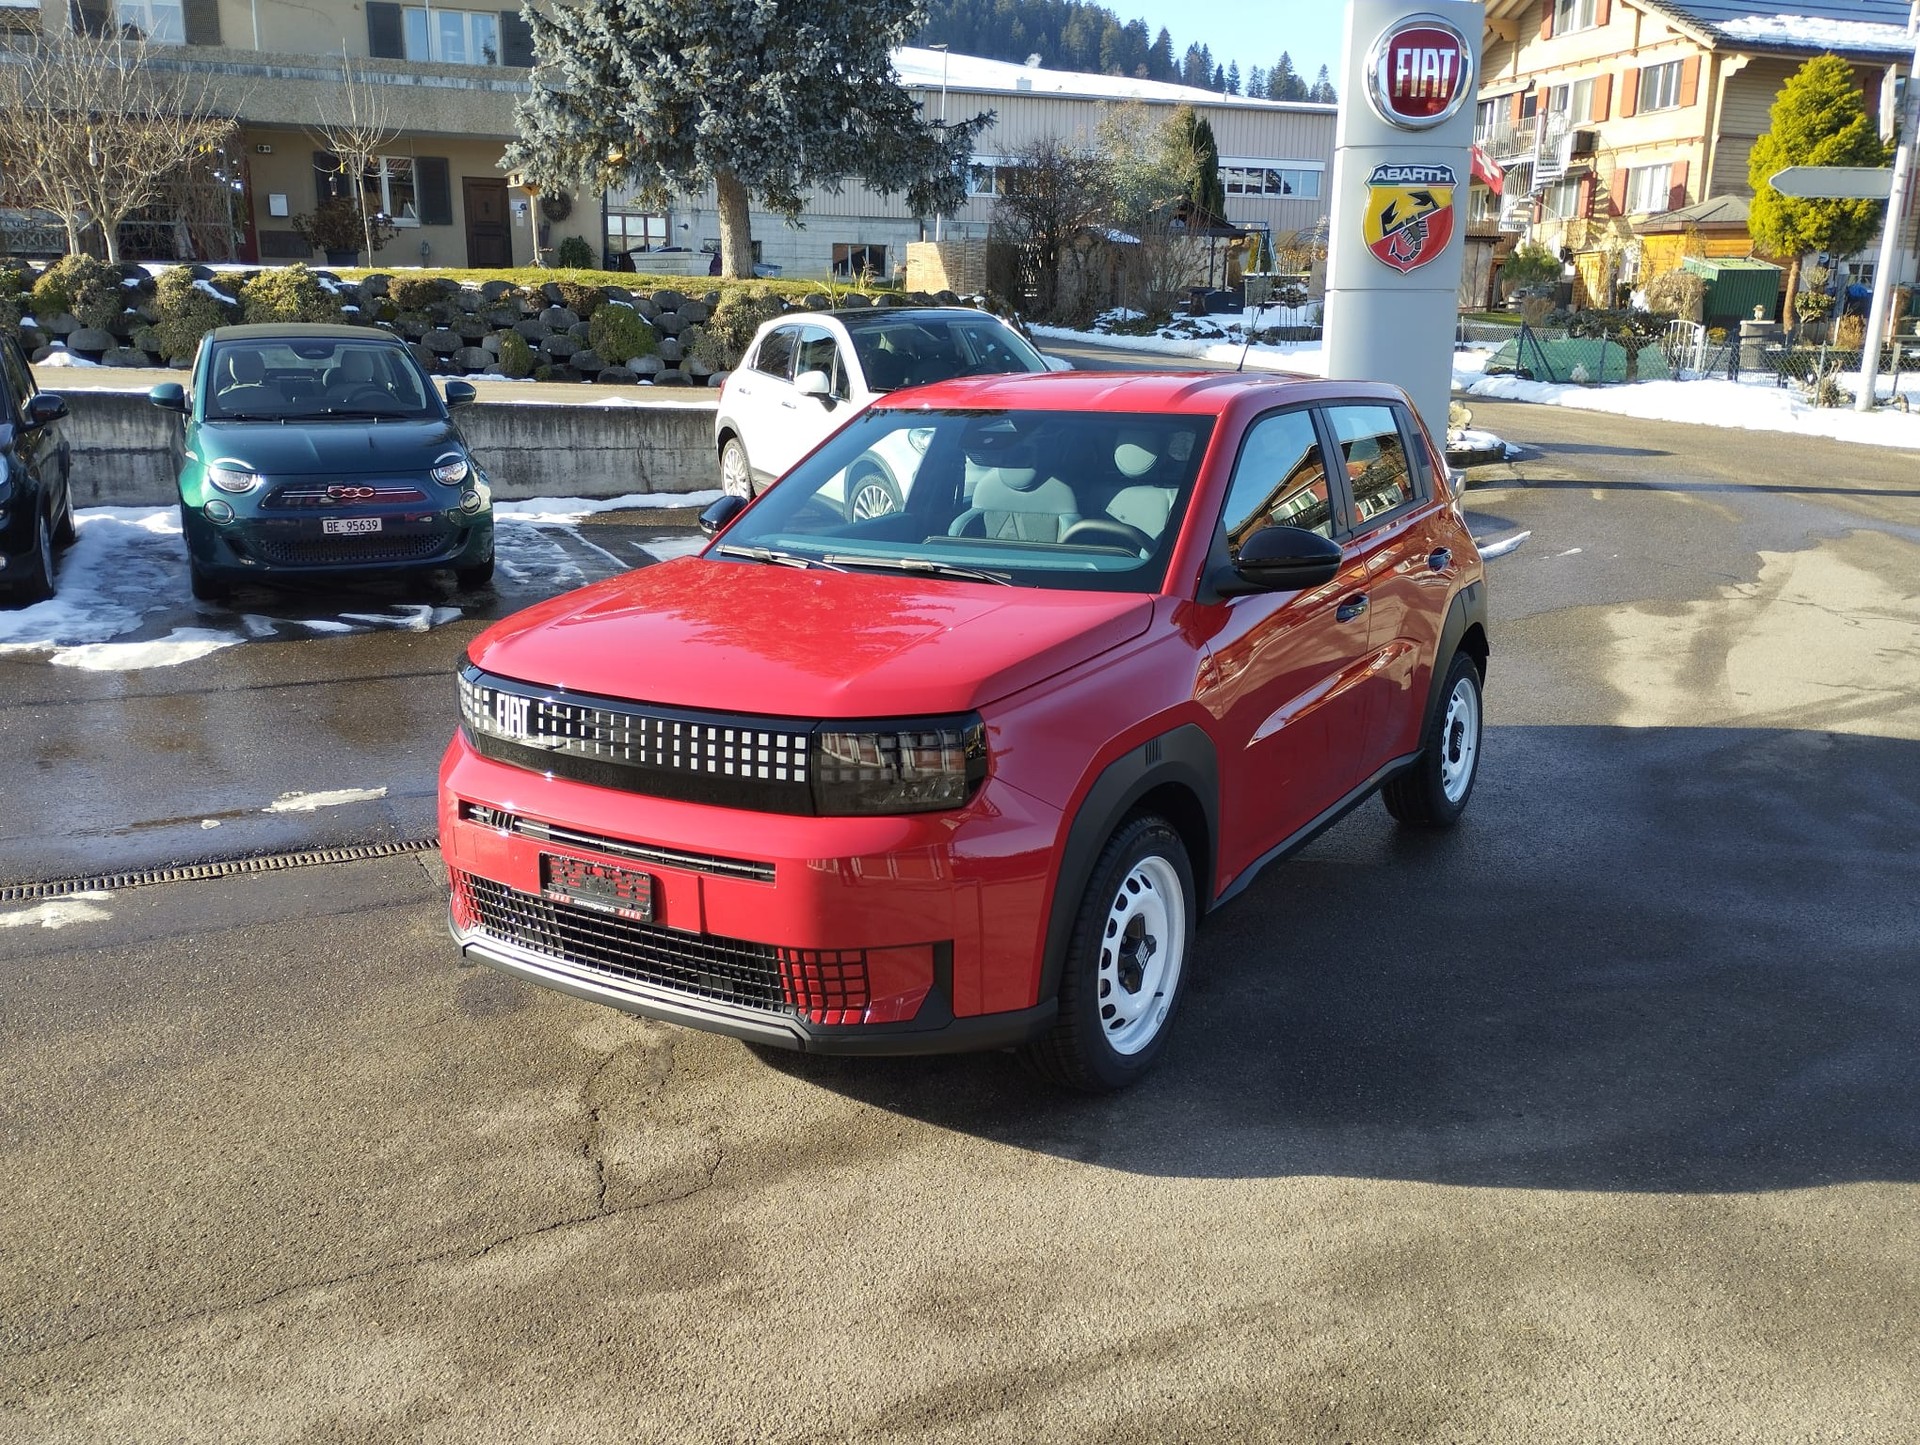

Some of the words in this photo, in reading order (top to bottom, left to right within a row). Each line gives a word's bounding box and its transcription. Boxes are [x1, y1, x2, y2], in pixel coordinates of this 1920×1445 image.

[1394, 48, 1456, 98] FIAT
[1373, 168, 1450, 182] ABARTH
[327, 485, 375, 498] 500
[496, 692, 531, 740] FIAT
